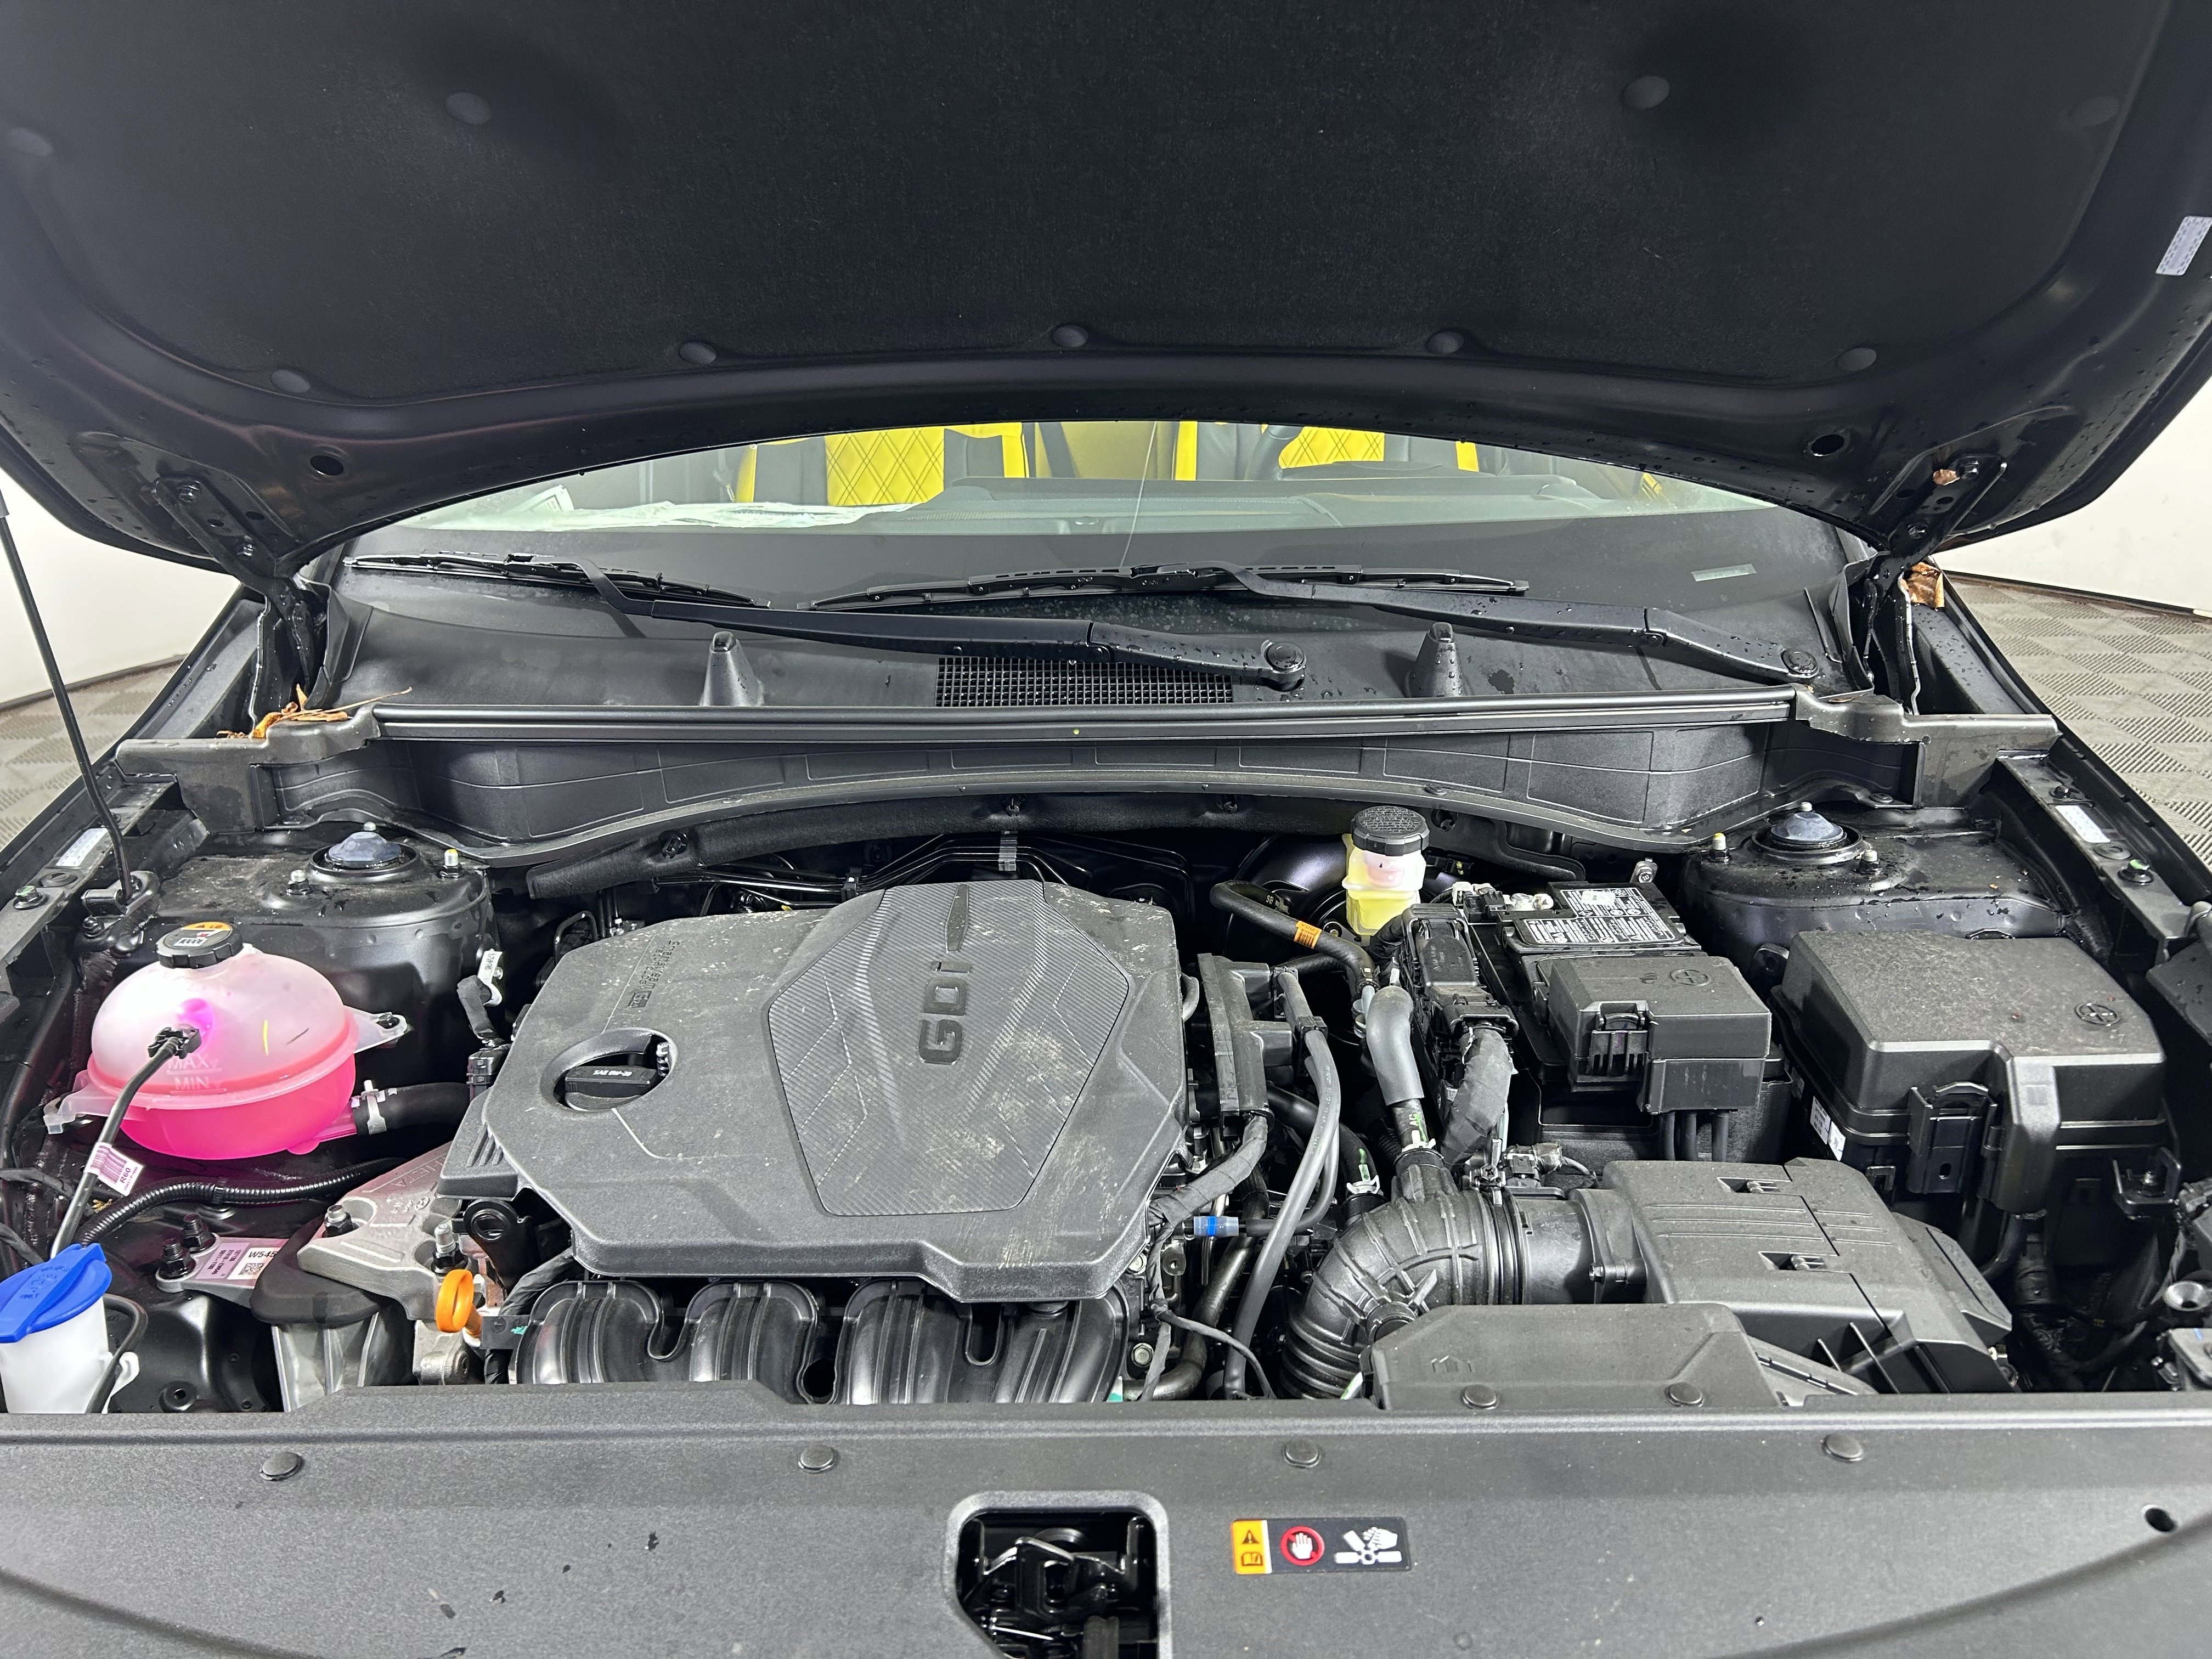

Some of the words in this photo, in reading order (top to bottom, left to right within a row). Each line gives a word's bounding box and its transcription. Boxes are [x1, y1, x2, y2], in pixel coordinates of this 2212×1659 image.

[168, 1053, 209, 1069] MAX
[174, 1076, 210, 1090] MIN
[120, 1167, 131, 1183] R60
